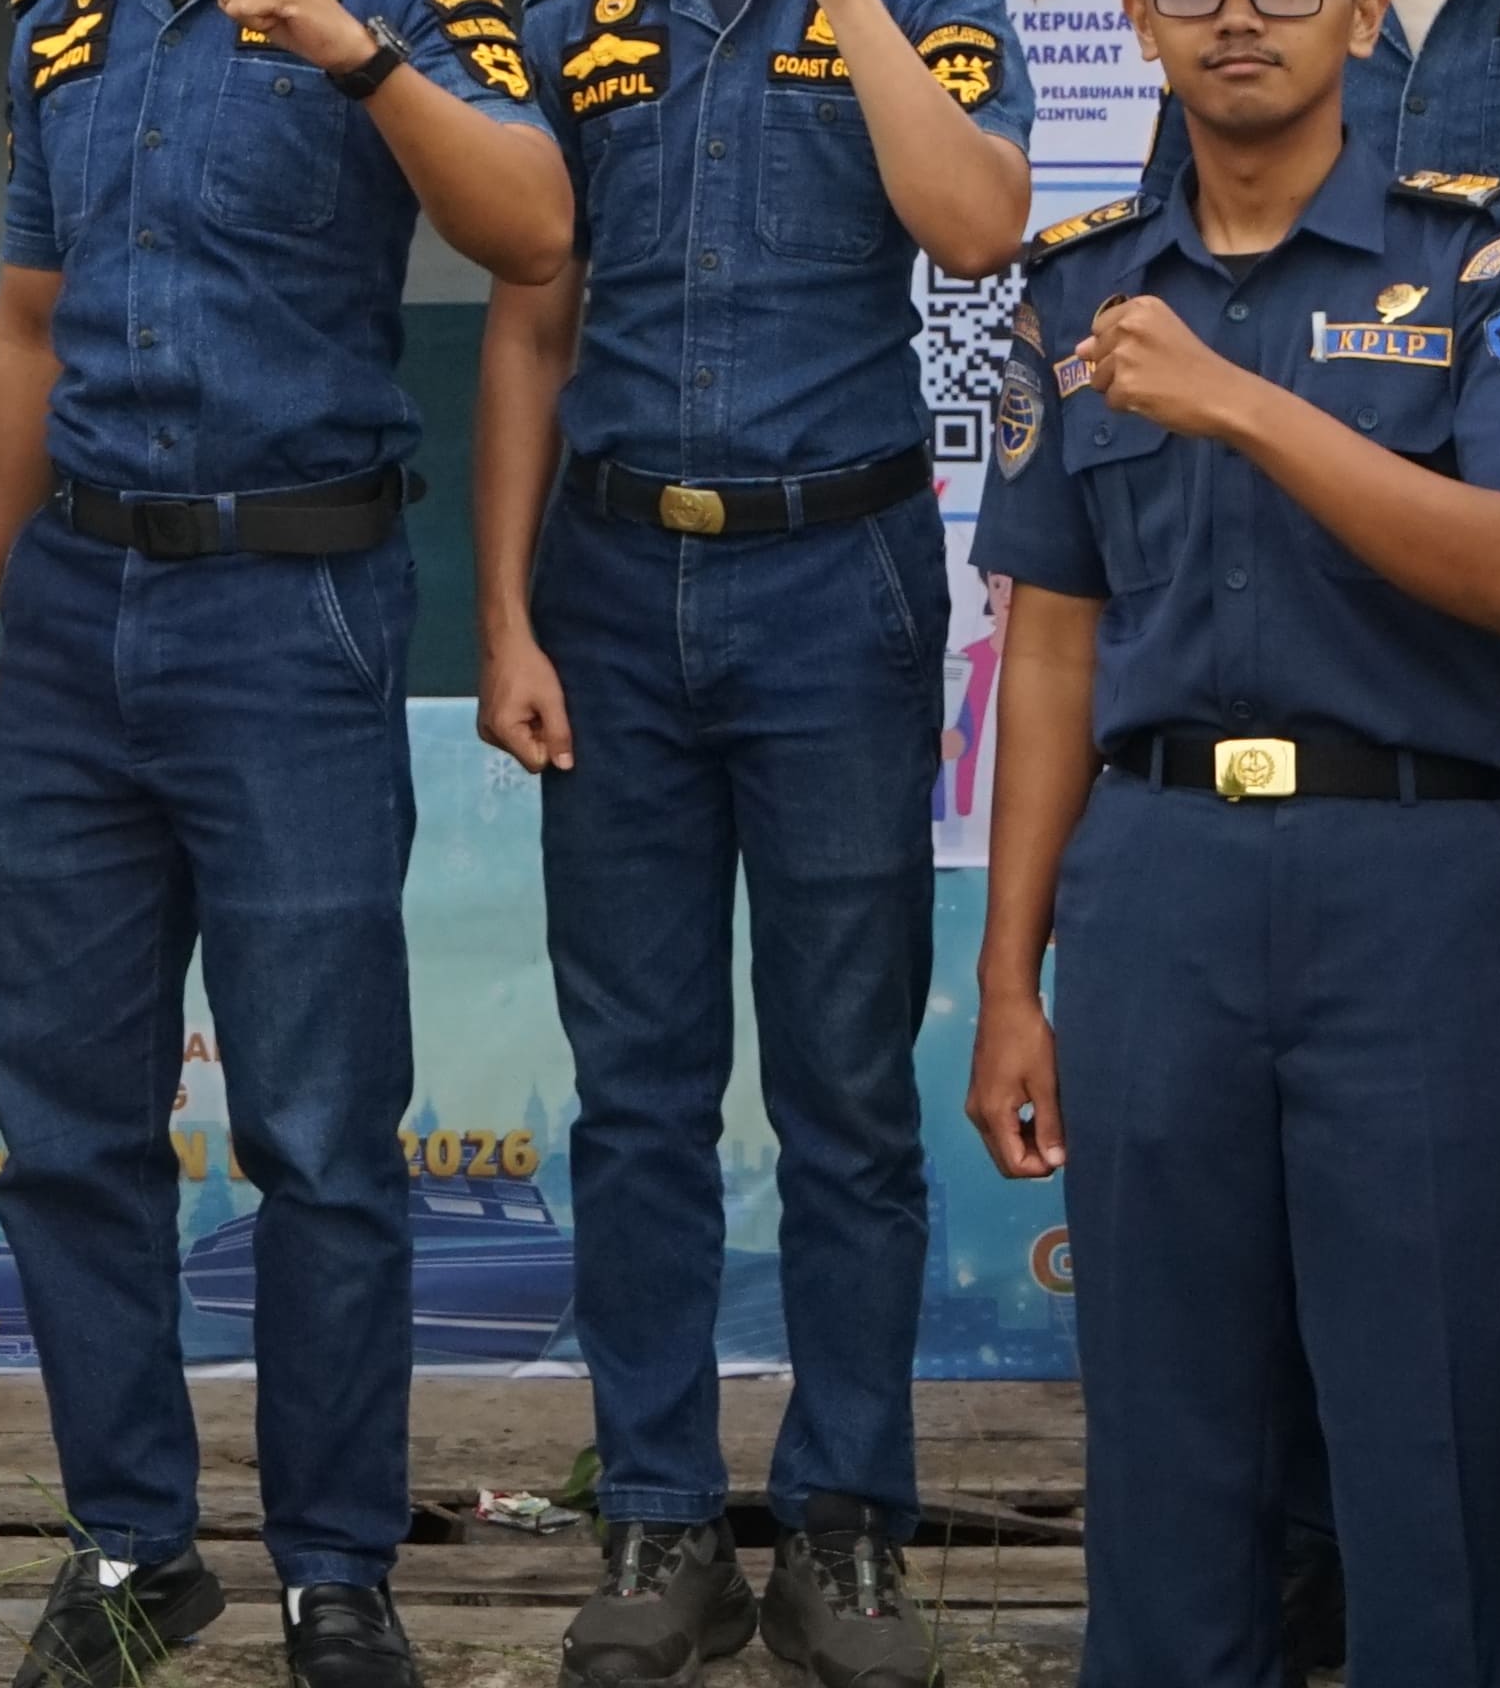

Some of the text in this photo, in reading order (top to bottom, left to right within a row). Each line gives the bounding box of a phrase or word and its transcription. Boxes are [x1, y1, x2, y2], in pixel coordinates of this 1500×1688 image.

[1023, 13, 1133, 31] KEPUASA
[1026, 45, 1122, 64] ARAKAT
[774, 54, 829, 79] COAST
[572, 73, 655, 112] SAIFUL
[1041, 86, 1134, 99] PELABUHAN
[1036, 107, 1107, 120] GINTUNG
[1339, 330, 1428, 355] KPLP
